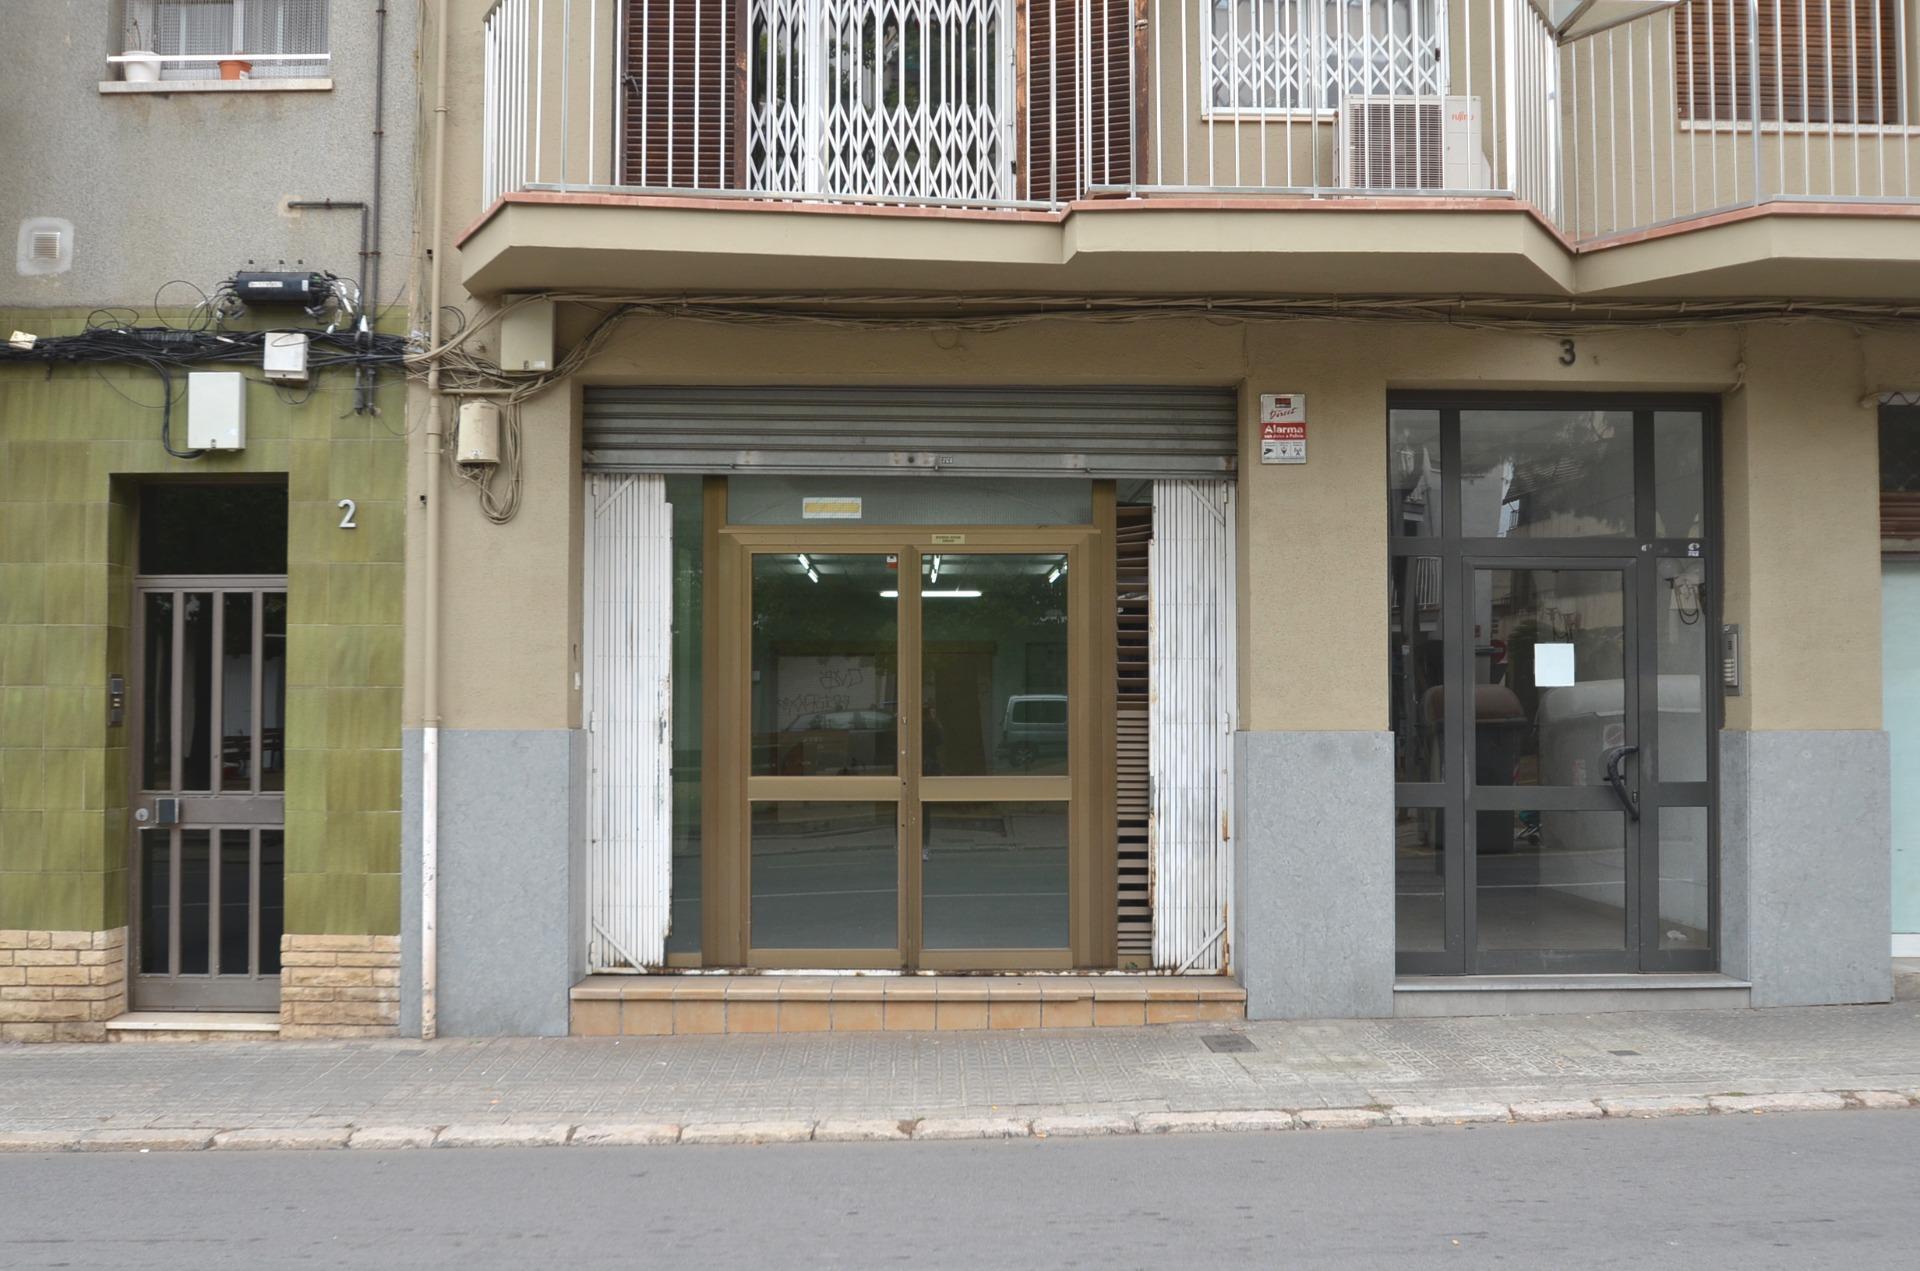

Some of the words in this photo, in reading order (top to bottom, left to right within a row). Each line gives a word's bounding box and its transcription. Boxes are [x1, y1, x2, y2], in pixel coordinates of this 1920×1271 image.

[1451, 111, 1474, 121] FUJITU
[1559, 339, 1576, 367] 3
[1264, 424, 1304, 434] Alarma
[338, 499, 356, 528] 2
